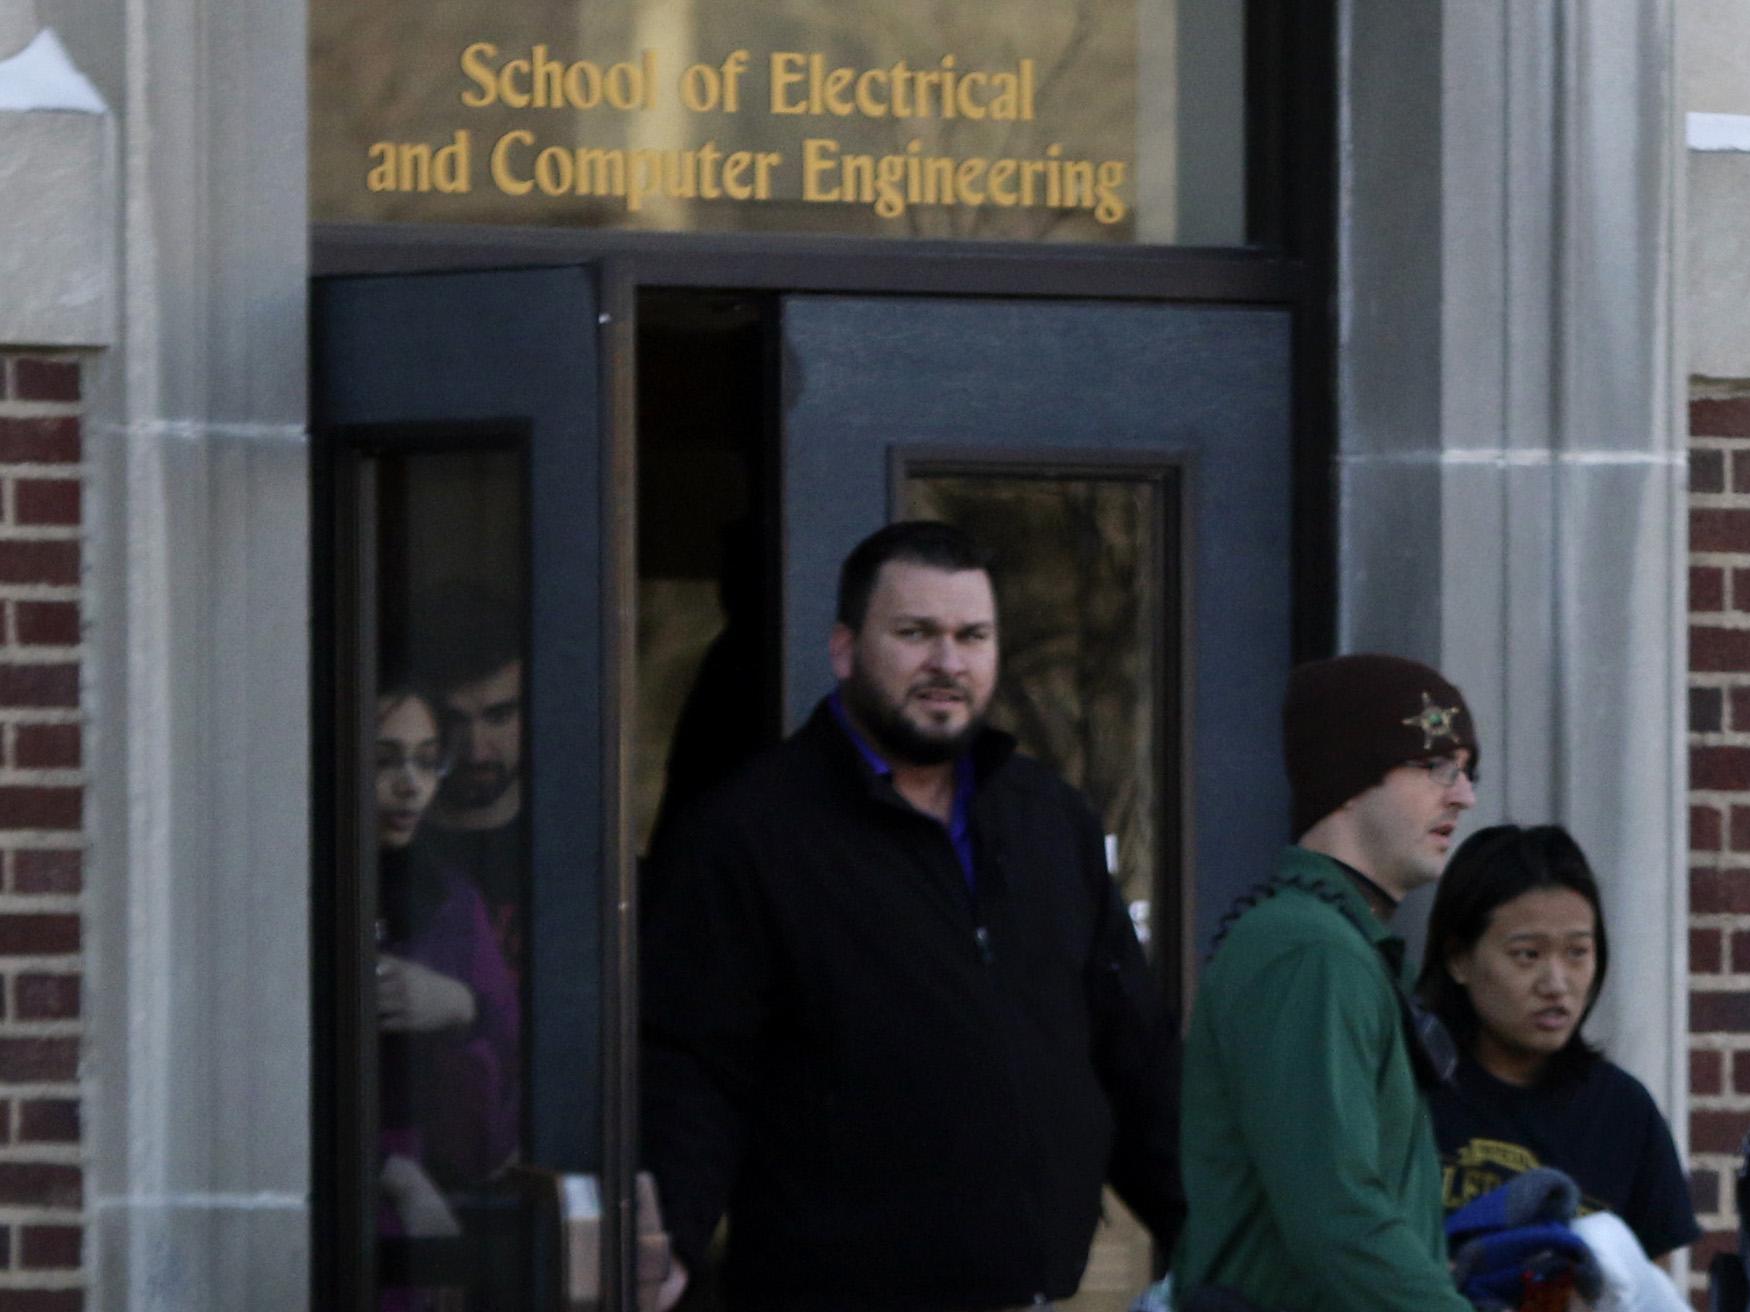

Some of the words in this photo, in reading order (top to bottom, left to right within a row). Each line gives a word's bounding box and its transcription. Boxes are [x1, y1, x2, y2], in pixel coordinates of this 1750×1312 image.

[460, 42, 656, 110] School
[681, 50, 752, 113] of
[770, 52, 1036, 120] Electrical
[366, 129, 471, 193] and
[490, 130, 782, 212] Computer
[803, 138, 1128, 224] Engineering
